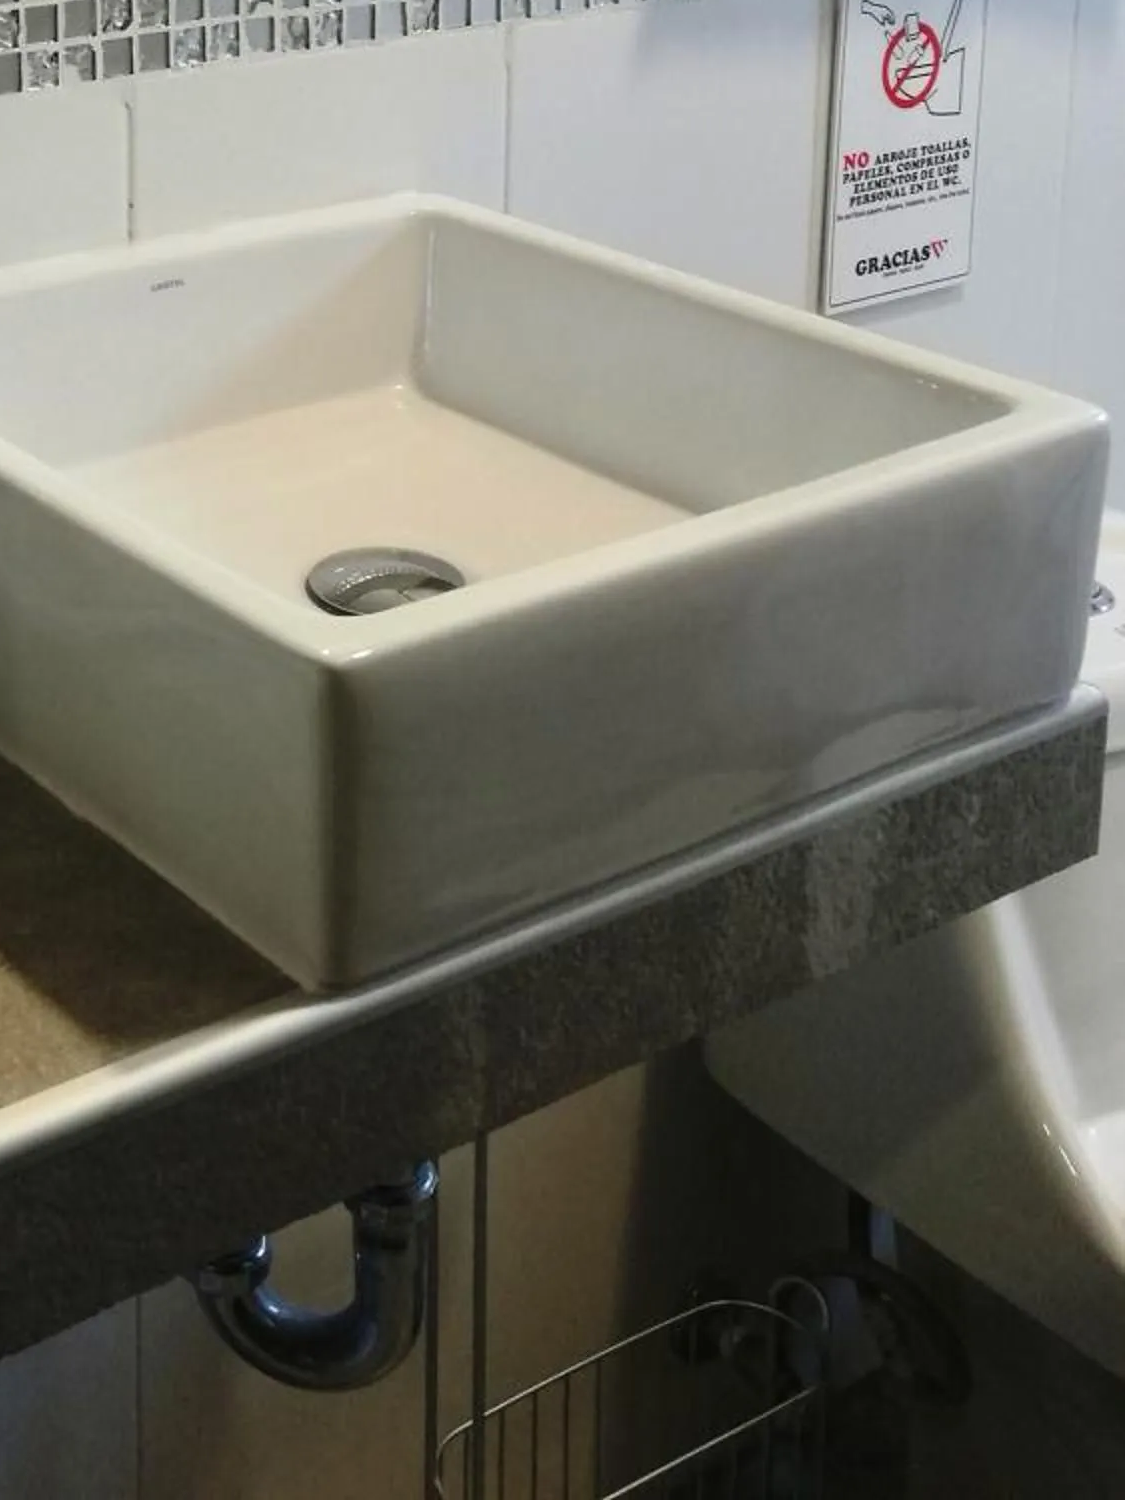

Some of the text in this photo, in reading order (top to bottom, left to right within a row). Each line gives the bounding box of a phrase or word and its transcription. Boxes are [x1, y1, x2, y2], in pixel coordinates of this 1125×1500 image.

[843, 152, 869, 171] NO
[875, 147, 917, 165] ARROJE
[897, 152, 960, 173] COMPRESAS
[962, 149, 970, 159] O
[854, 163, 959, 194] ELEMENTOS DE USO
[849, 186, 907, 208] PERSONAL
[909, 182, 923, 195] EN
[926, 180, 939, 191] EL
[855, 245, 931, 276] GRACIAS
